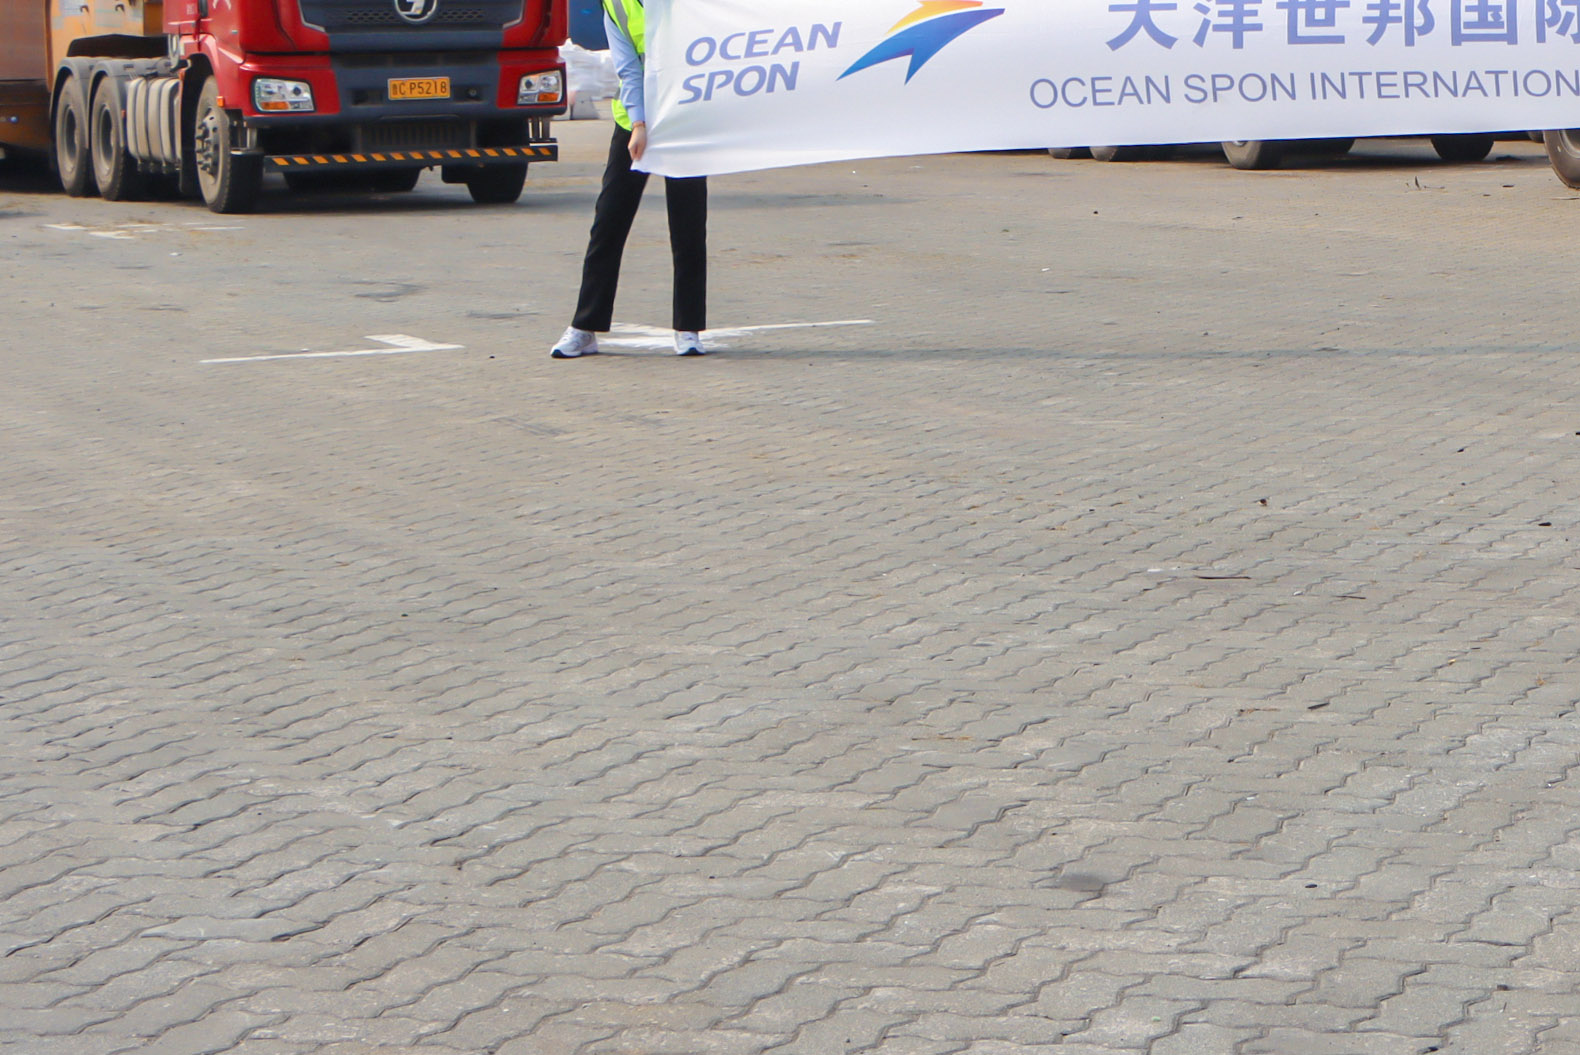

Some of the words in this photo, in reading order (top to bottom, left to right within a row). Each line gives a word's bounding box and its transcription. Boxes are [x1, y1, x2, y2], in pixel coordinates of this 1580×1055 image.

[685, 21, 842, 66] OCEAN
[678, 61, 800, 105] SPON
[1029, 75, 1172, 109] OCEAN
[1183, 71, 1297, 104] SPON
